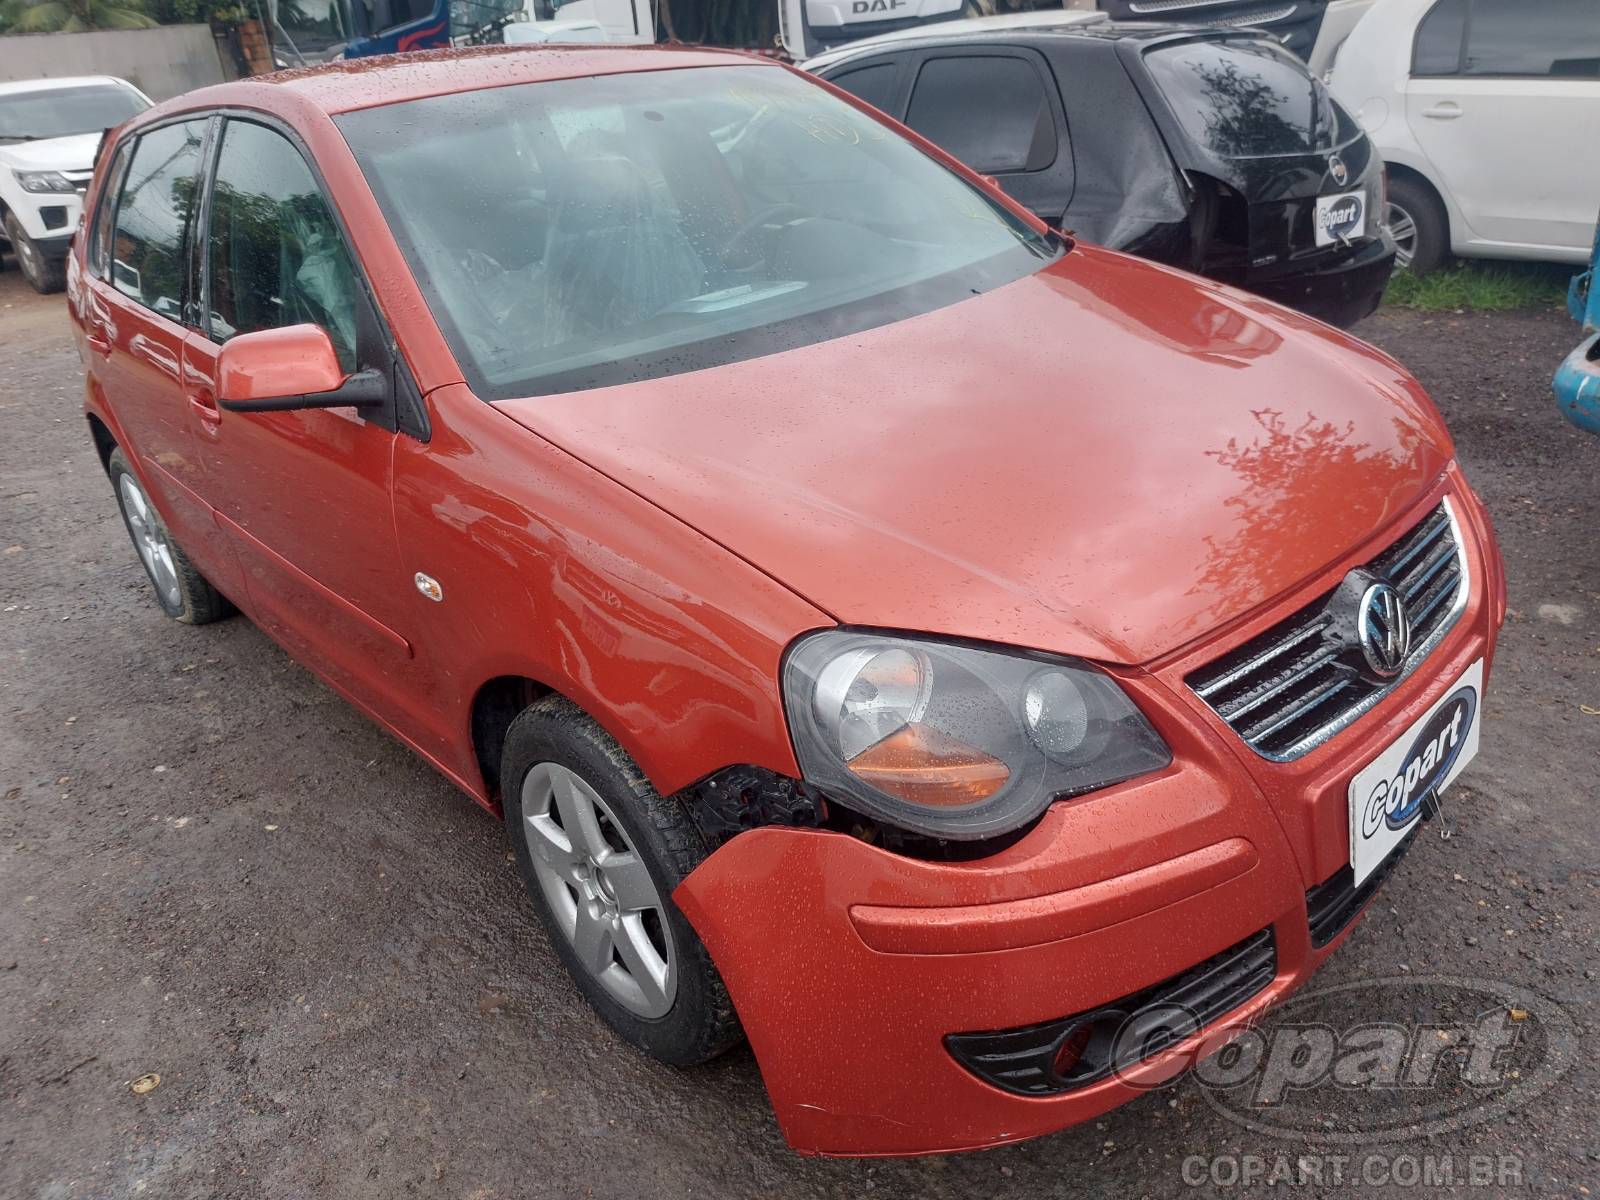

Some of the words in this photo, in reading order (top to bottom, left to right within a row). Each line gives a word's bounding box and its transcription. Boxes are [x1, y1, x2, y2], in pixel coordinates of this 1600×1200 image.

[852, 0, 906, 13] DAF
[1319, 203, 1356, 229] Copart
[1362, 703, 1464, 840] Copart
